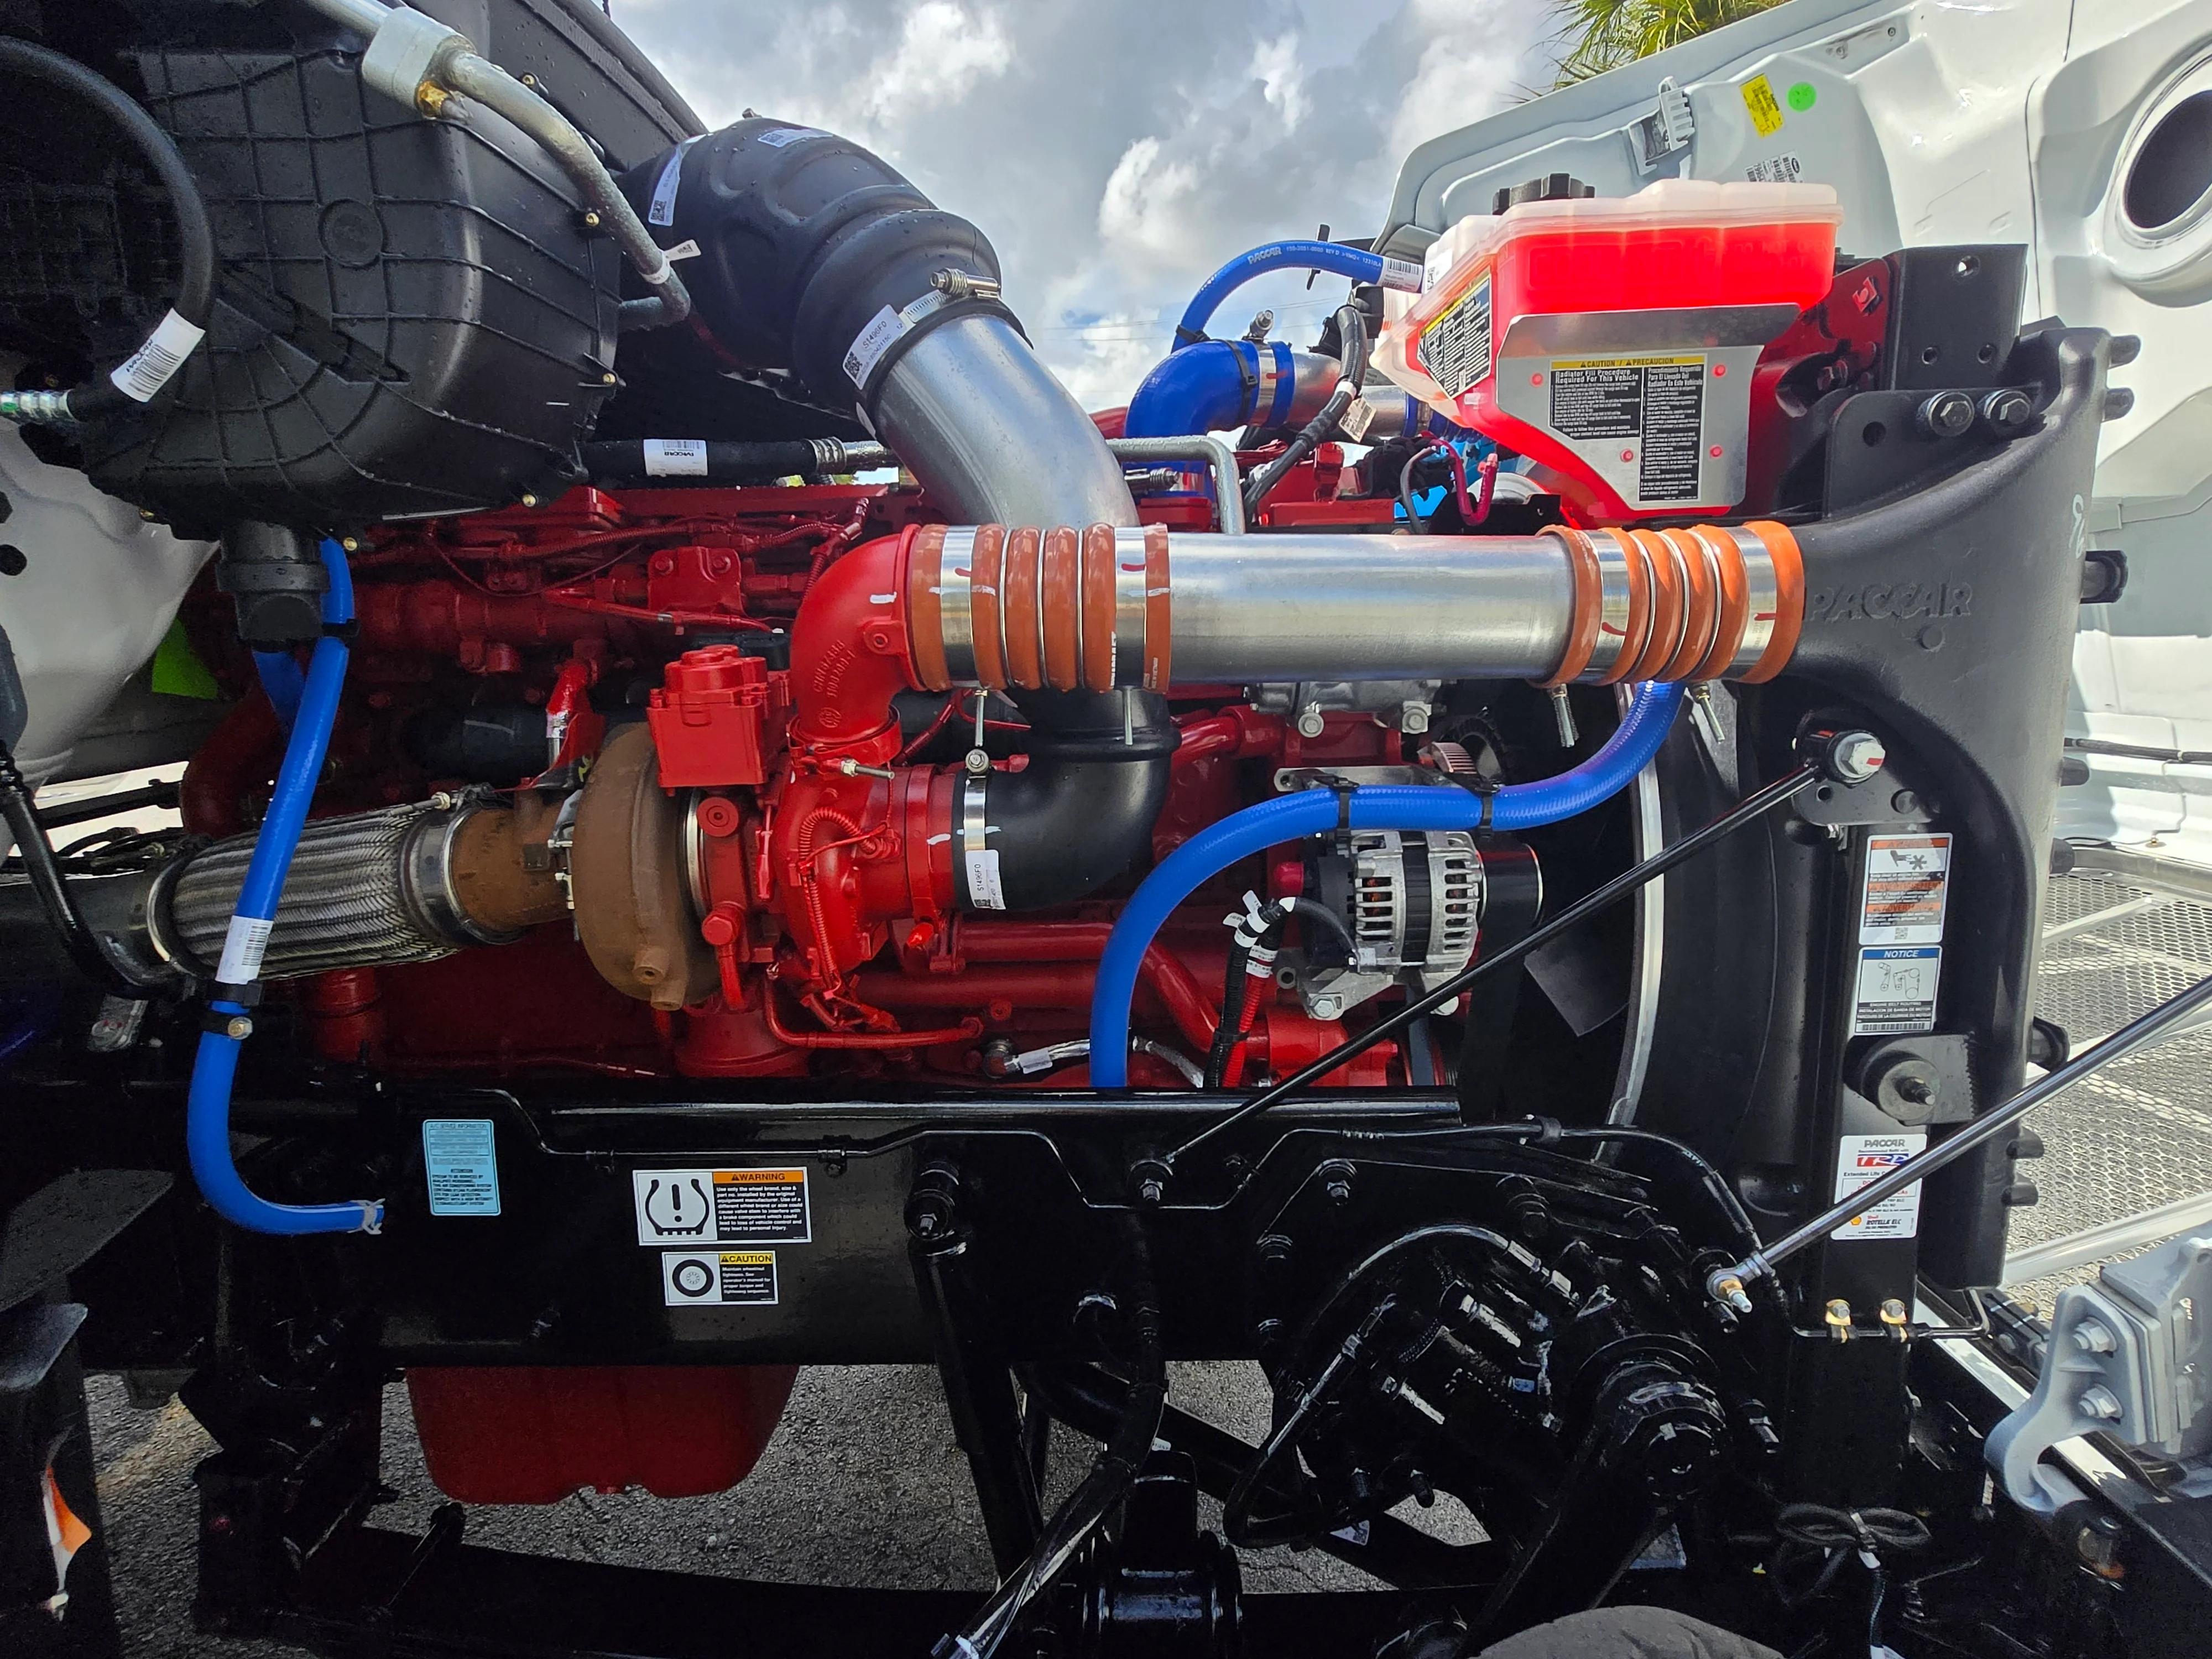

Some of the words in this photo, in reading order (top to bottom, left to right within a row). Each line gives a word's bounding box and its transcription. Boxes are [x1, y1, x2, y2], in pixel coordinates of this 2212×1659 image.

[1247, 247, 1282, 264] PACCAR
[1805, 582, 1973, 623] PACCAR
[974, 864, 984, 890] S1496F0
[1864, 1139, 1906, 1147] PACCAR
